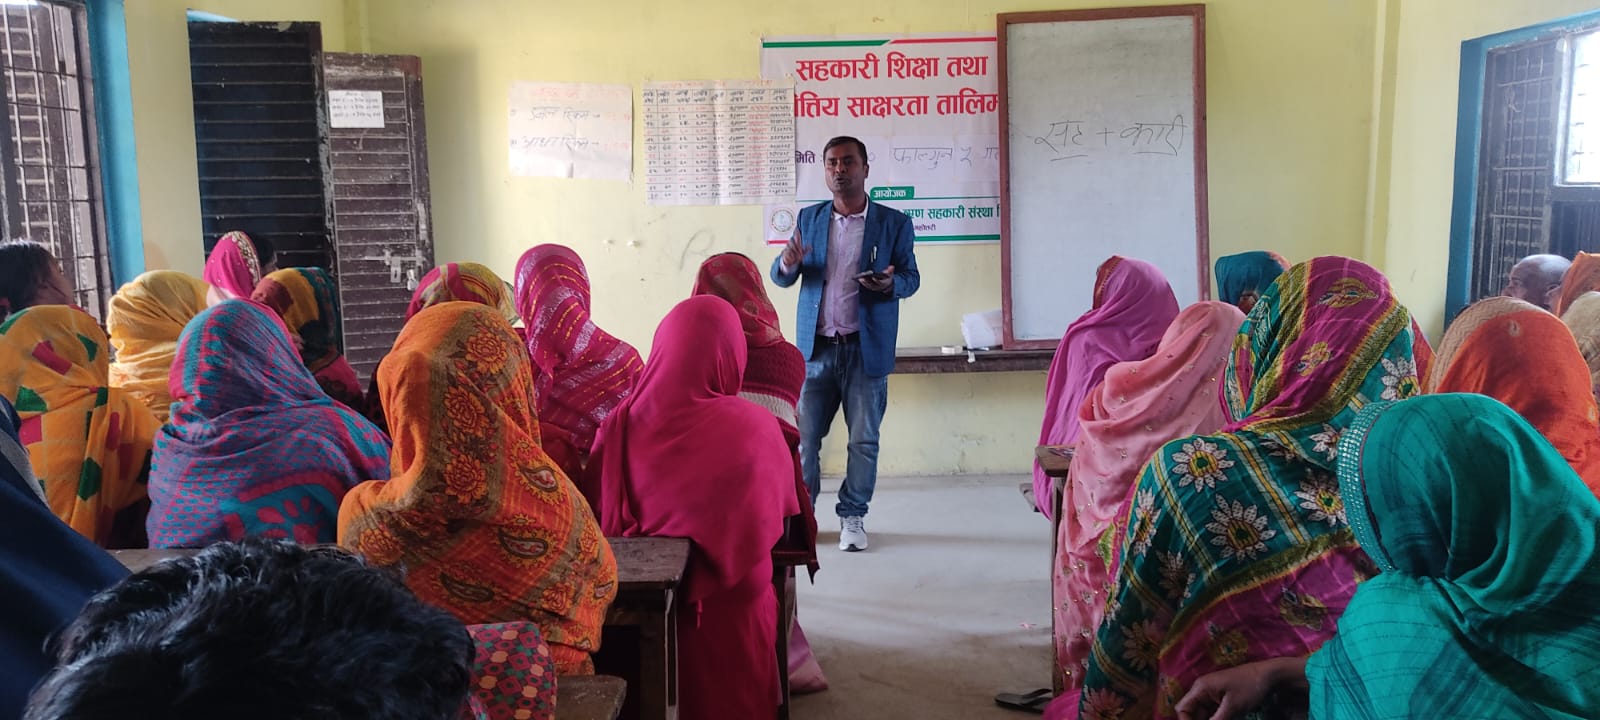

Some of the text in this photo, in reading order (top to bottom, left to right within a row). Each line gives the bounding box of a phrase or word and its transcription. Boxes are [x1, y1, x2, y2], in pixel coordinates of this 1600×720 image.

[796, 51, 988, 81] सहकारी शिक्षा तथा
[847, 96, 929, 118] साक्षरता
[873, 188, 906, 199] आयोजक
[927, 204, 965, 220] सहकारी
[968, 204, 993, 219] संस्था
